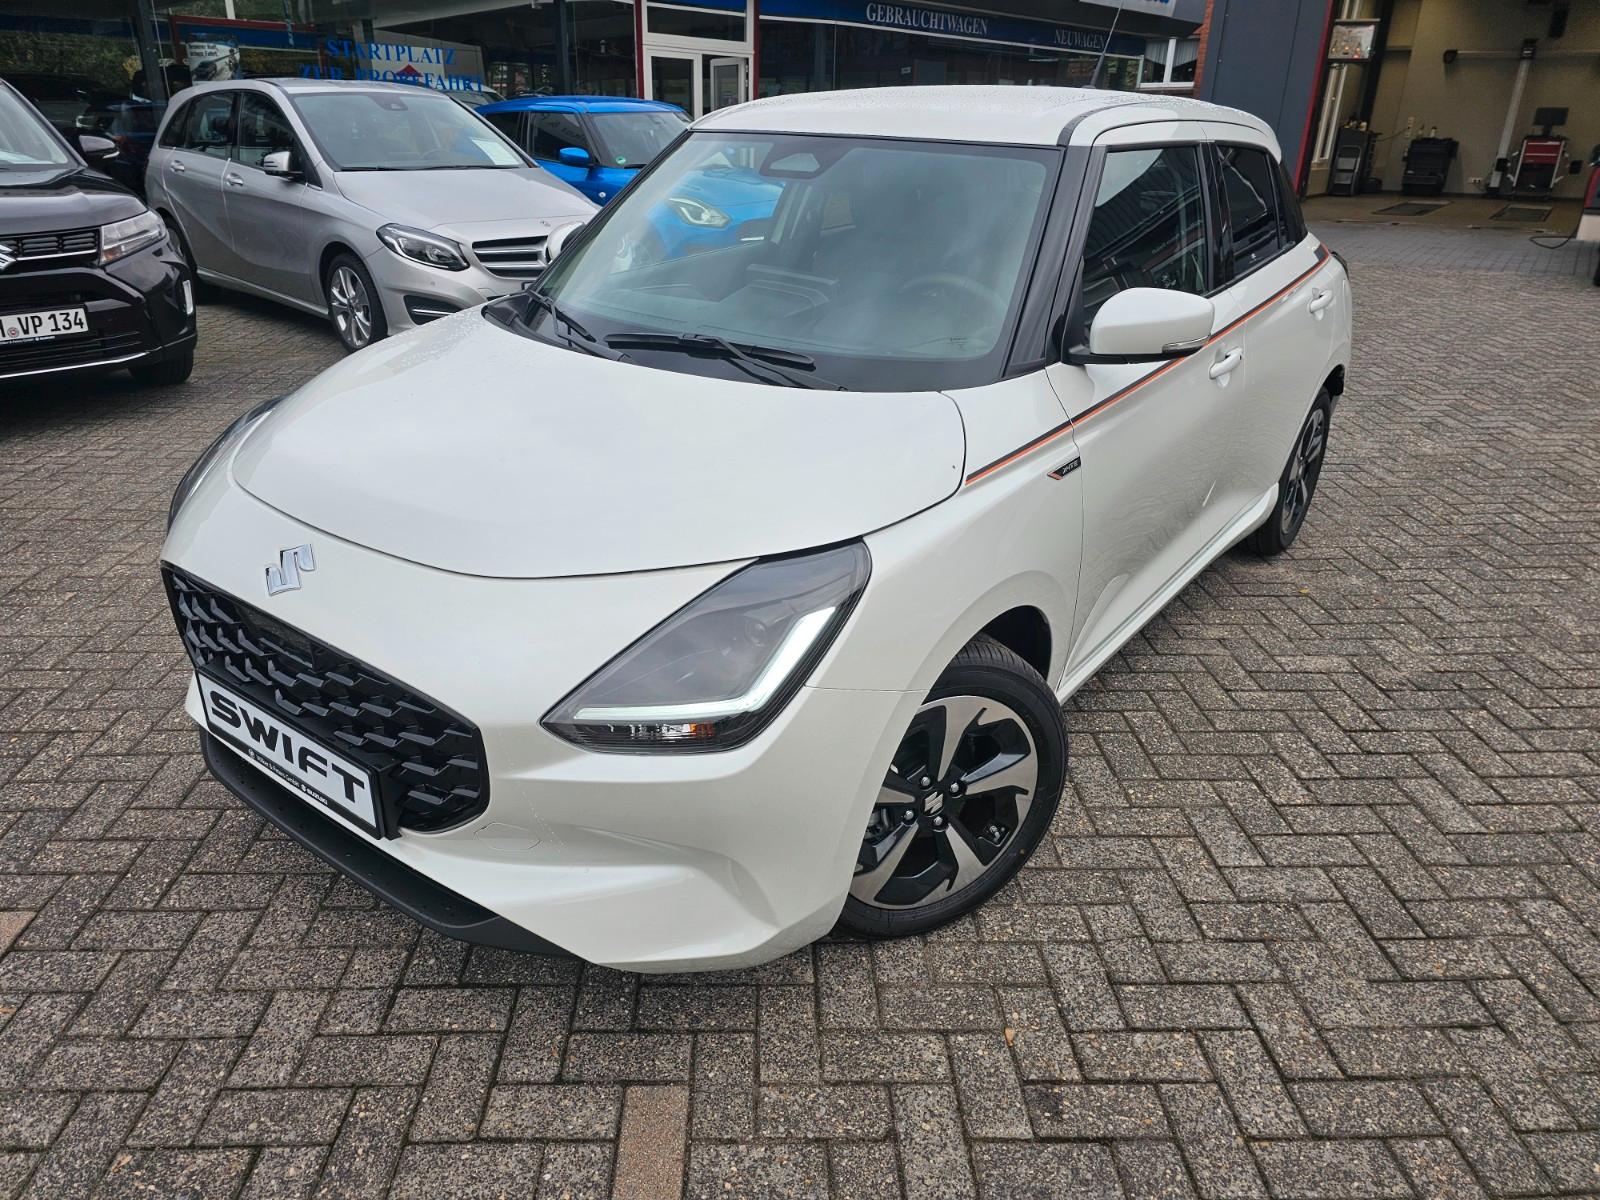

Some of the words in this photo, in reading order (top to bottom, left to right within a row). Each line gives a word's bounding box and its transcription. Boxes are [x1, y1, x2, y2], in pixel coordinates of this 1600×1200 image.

[866, 2, 989, 35] GEBRAUCHTWAGEN
[327, 39, 457, 65] STARTPLATZ
[1054, 29, 1106, 49] NEUWAGEN
[17, 315, 43, 335] VP
[48, 311, 84, 332] 134
[210, 690, 365, 803] SWIFT
